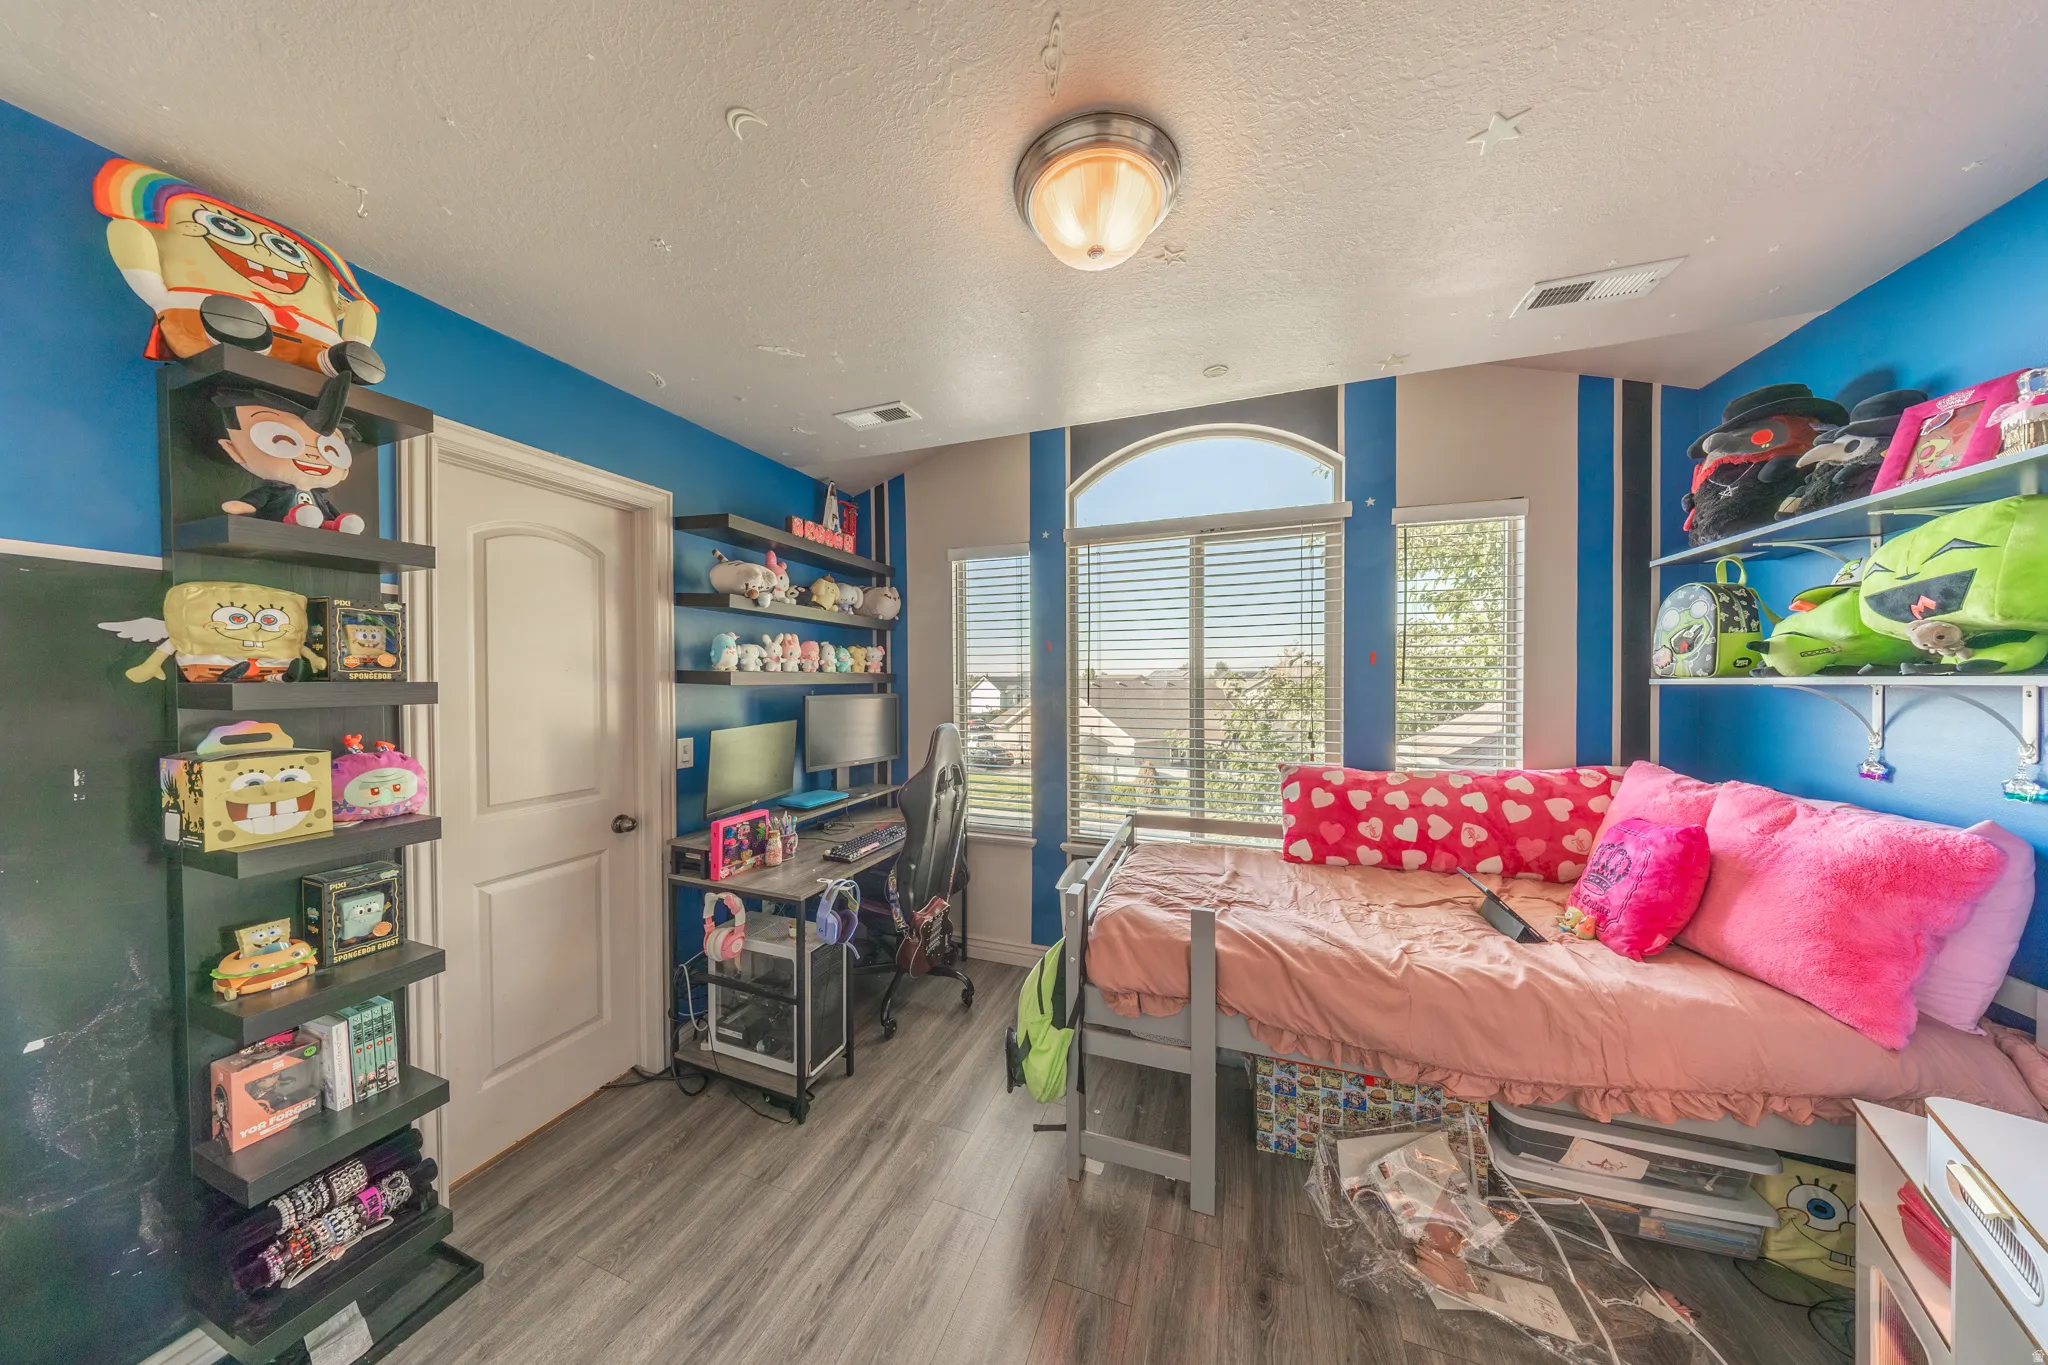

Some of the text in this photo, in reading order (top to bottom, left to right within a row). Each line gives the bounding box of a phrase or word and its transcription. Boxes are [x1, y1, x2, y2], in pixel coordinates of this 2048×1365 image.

[334, 599, 351, 607] PIXI
[349, 672, 392, 680] SPONGEBOB
[329, 881, 347, 891] PIXI
[333, 938, 400, 964] SPONGEBOB GHOST
[239, 1121, 267, 1138] YOR
[269, 1099, 317, 1126] FORGER
